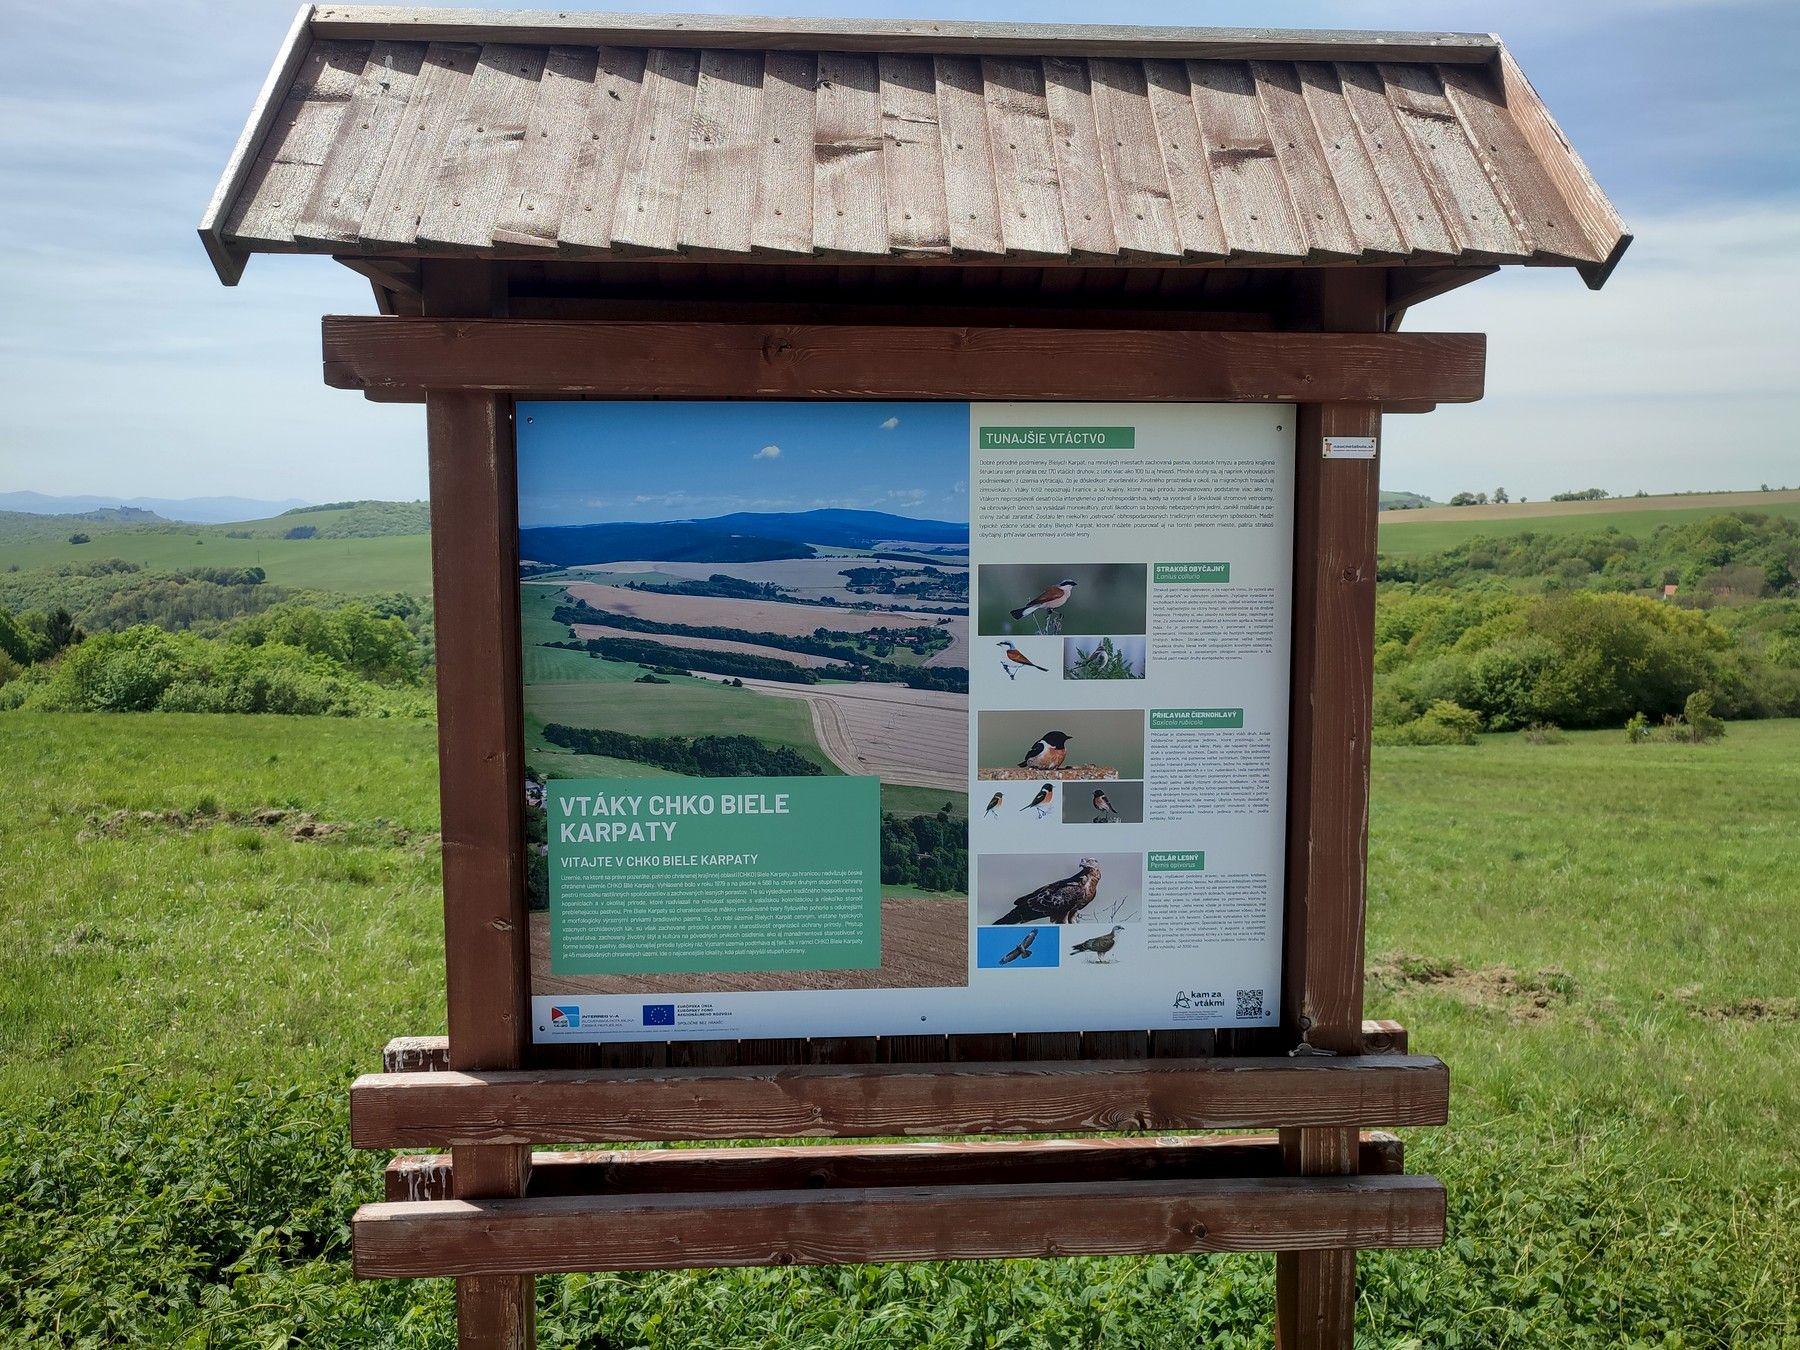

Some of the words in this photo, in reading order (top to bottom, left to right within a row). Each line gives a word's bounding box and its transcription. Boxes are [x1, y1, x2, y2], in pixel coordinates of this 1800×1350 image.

[986, 430, 1046, 444] TUNAJŠIE
[1050, 431, 1106, 444] VTÁCTVO
[1156, 565, 1188, 573] STRAKOŠ
[1188, 564, 1225, 573] OBYČAJNÝ
[559, 792, 642, 817] VTÁKY
[649, 795, 715, 816] CHKO
[721, 794, 790, 814] BIELE
[560, 821, 677, 843] KARPATY
[560, 856, 613, 867] VITAJTE
[615, 856, 624, 866] V
[626, 856, 660, 866] CHKO
[662, 855, 698, 866] BIELE
[701, 854, 758, 865] KARPATY
[1194, 999, 1225, 1007] vtákmi
